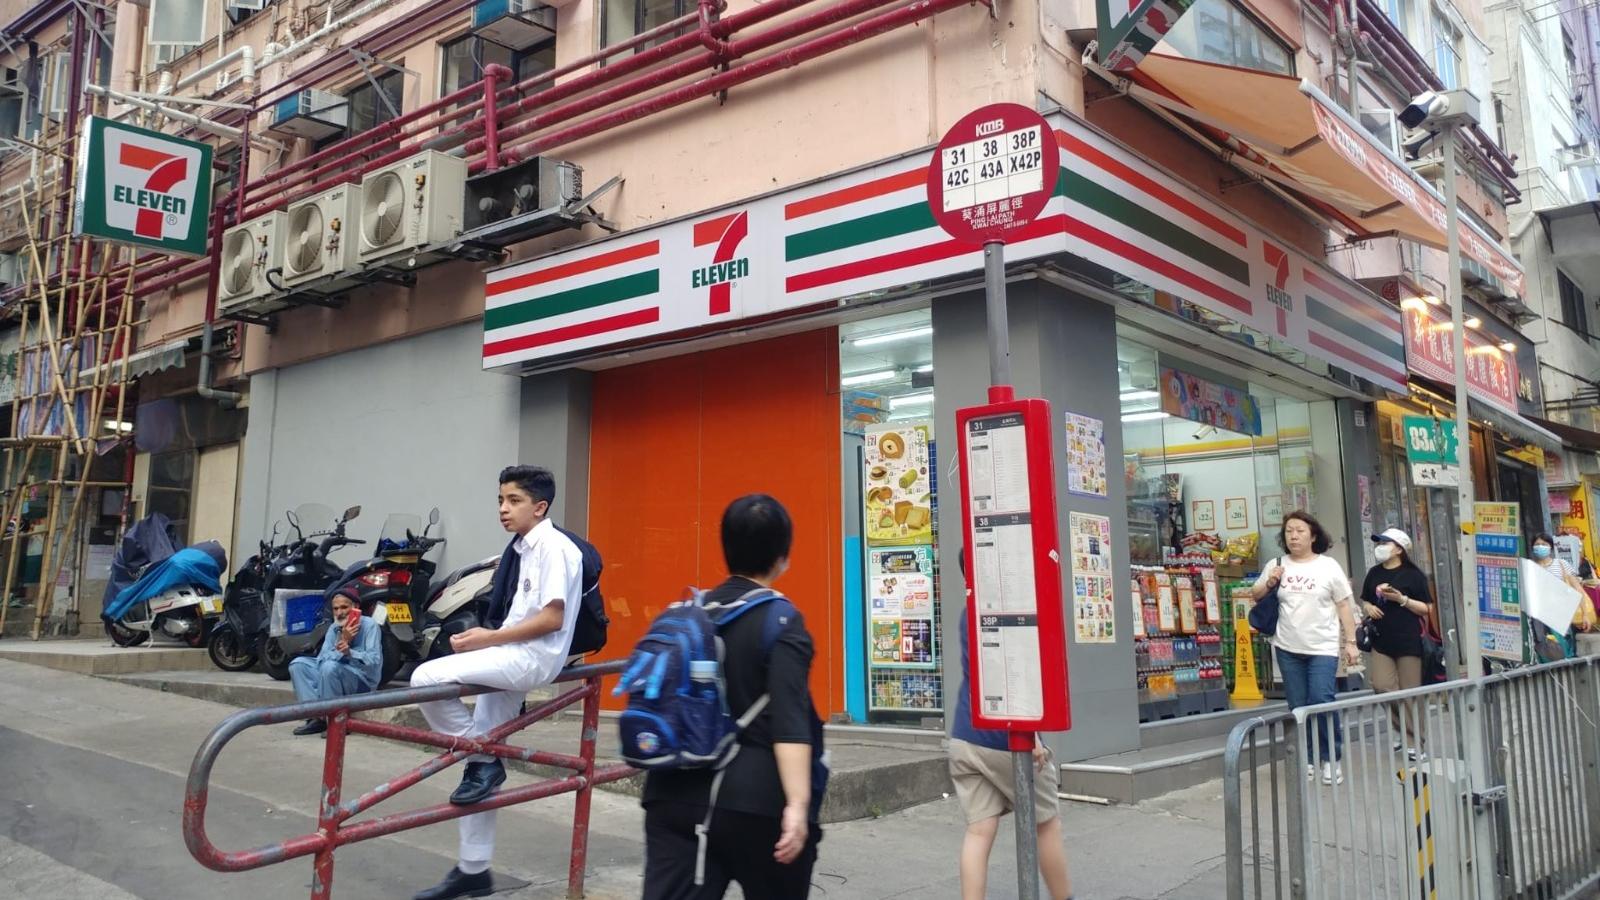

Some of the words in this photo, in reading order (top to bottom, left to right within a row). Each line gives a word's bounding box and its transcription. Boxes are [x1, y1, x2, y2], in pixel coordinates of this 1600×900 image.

[975, 119, 1004, 137] KMB
[951, 148, 966, 166] 31
[983, 140, 998, 158] 38
[1012, 131, 1036, 150] 38P
[947, 169, 969, 187] 42C
[980, 161, 1004, 179] 43A
[1010, 151, 1041, 173] X42P
[119, 143, 188, 239] 7
[693, 210, 748, 316] 7
[1262, 240, 1289, 337] 7
[974, 422, 983, 431] 31
[979, 517, 989, 526] 38
[982, 616, 997, 626] 38P
